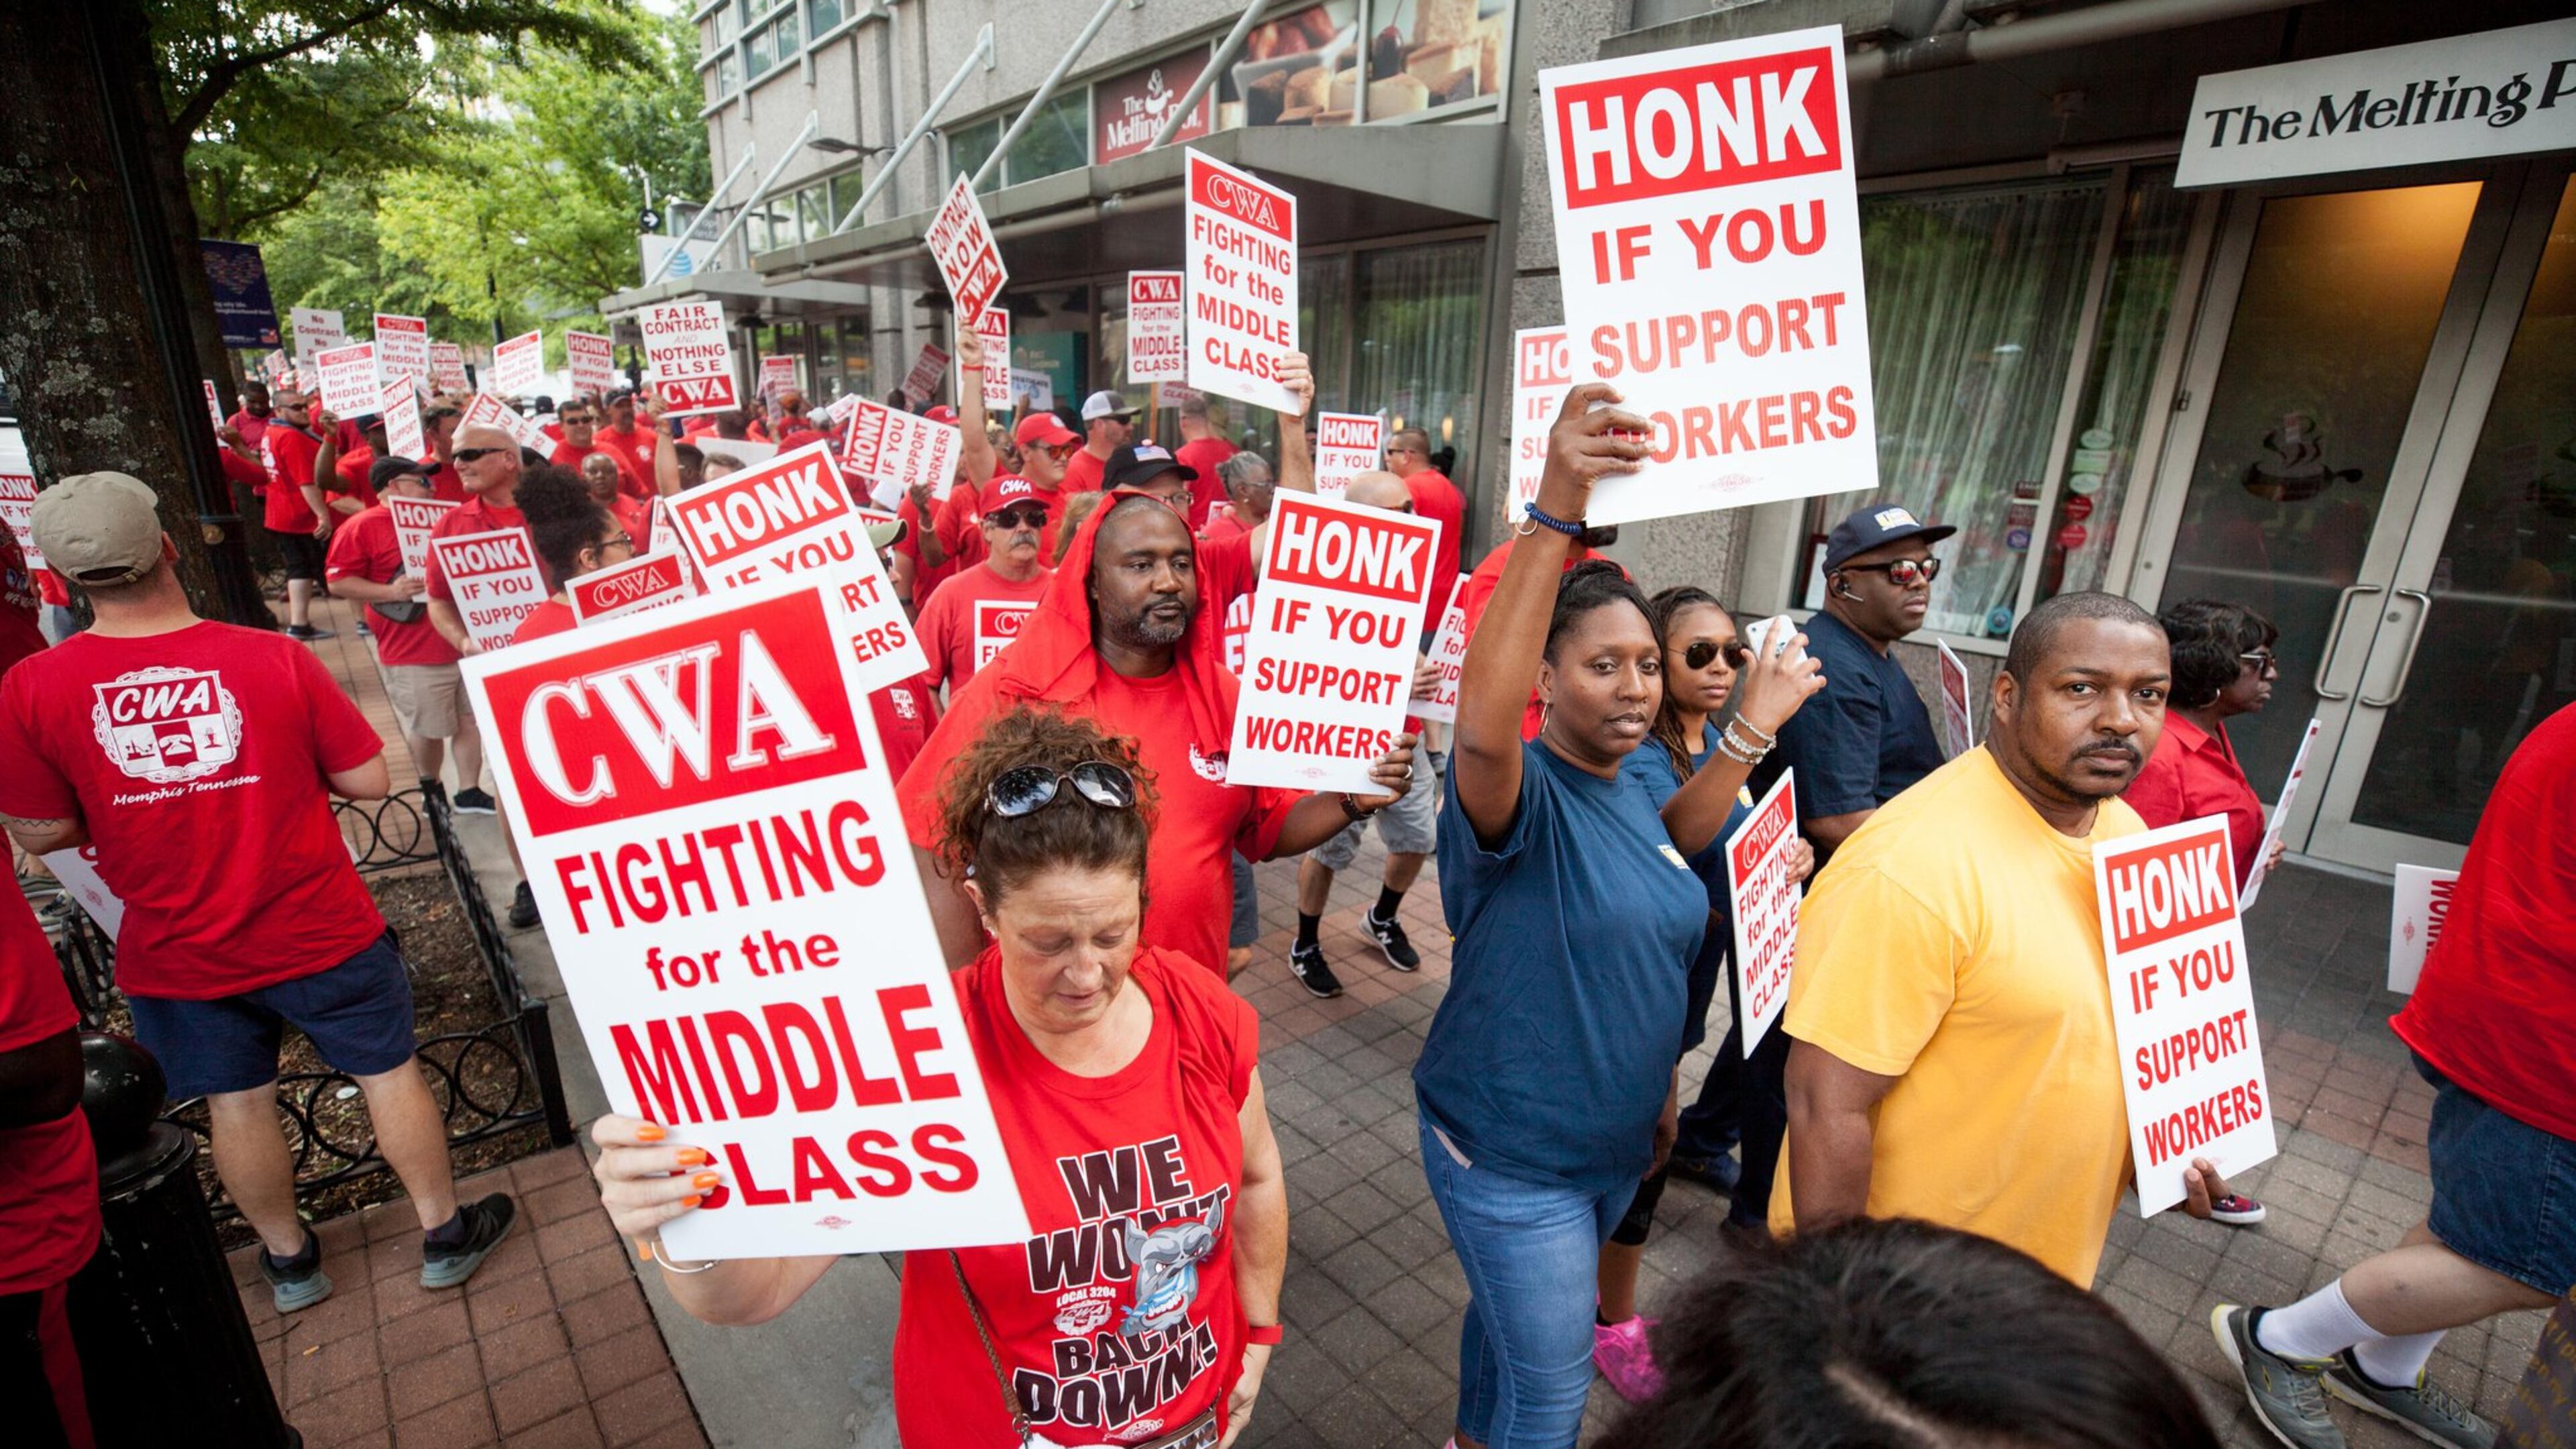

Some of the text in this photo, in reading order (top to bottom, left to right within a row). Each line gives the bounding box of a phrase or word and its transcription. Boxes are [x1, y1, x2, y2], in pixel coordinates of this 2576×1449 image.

[1122, 97, 1144, 115] The
[2205, 105, 2302, 148] The
[2307, 72, 2532, 138] Melting
[1568, 66, 1827, 191] HONK
[1207, 174, 1279, 231] CWA
[930, 182, 973, 260] CONTRACT
[945, 217, 983, 287] NOW
[1194, 214, 1291, 275] FIGHTING
[1592, 199, 1827, 285] IF YOU
[958, 256, 999, 319] CWA
[1134, 279, 1178, 300] CWA
[1203, 254, 1284, 306] for the
[311, 315, 325, 324] No
[383, 319, 419, 331] CWA
[645, 317, 718, 335] CONTRACT
[655, 305, 706, 320] FAIR
[979, 313, 1004, 334] WA
[1132, 307, 1180, 321] FIGHTING
[1197, 292, 1290, 347] MIDDLE
[298, 325, 340, 337] Contract
[379, 332, 425, 343] FIGHTING
[674, 335, 698, 344] AND
[1141, 324, 1154, 333] for
[1591, 291, 1845, 380] SUPPORT
[315, 339, 327, 347] No
[384, 343, 422, 353] for the
[570, 335, 610, 356] HONK
[651, 343, 725, 362] NOTHING
[983, 339, 1006, 353] TING
[1132, 335, 1181, 356] MIDDLE
[322, 361, 374, 378] FIGHTING
[382, 354, 425, 365] MIDDLE
[587, 358, 608, 368] YOU
[661, 360, 722, 376] ELSE
[1133, 358, 1180, 372] CLASS
[1525, 341, 1570, 381] HO
[329, 372, 371, 388] for the
[574, 369, 611, 380] SUPPORT
[985, 366, 1008, 385] DLE
[327, 384, 376, 402] MIDDLE
[661, 377, 729, 404] CWA
[983, 387, 1008, 400] ASS
[333, 396, 374, 413] CLASS
[1527, 396, 1553, 419] IF
[1324, 421, 1377, 448] HONK
[1600, 386, 1857, 464] ORKERS
[849, 406, 887, 474] HONK
[882, 417, 906, 475] IF YOU
[903, 422, 928, 485] SUPPORT
[1324, 453, 1373, 468] IF YOU
[0, 478, 34, 498] ONK
[1000, 480, 1032, 495] CWA
[1320, 476, 1350, 489] SUPP
[1, 506, 13, 517] IF
[686, 462, 839, 558] HONK
[406, 534, 421, 546] IF
[770, 530, 855, 574] YOU
[1276, 512, 1425, 593] HONK
[443, 538, 527, 575] HONK
[462, 576, 533, 600] IF YOU
[593, 566, 669, 608] CWA
[1271, 598, 1311, 634] IF
[1326, 605, 1405, 649] YOU
[1254, 657, 1401, 706] SUPPORT
[112, 680, 211, 722] CWA
[521, 629, 837, 806] CWA
[1246, 716, 1391, 759] WORKERS
[113, 773, 261, 806] Memphis Tennessee
[1743, 802, 1786, 869] CWA
[555, 800, 887, 935] FIGHTING
[2112, 843, 2230, 941] HONK
[1747, 912, 1766, 951] for
[1746, 901, 1798, 993] MIDDLE
[646, 930, 841, 992] for the
[2129, 940, 2235, 1015] IF YOU
[610, 983, 961, 1126] MIDDLE
[2135, 1008, 2248, 1092] SUPPORT
[2144, 1079, 2263, 1168] WORKERS
[1057, 1134, 1193, 1223] WE
[1056, 1286, 1116, 1309] LOCAL 3204
